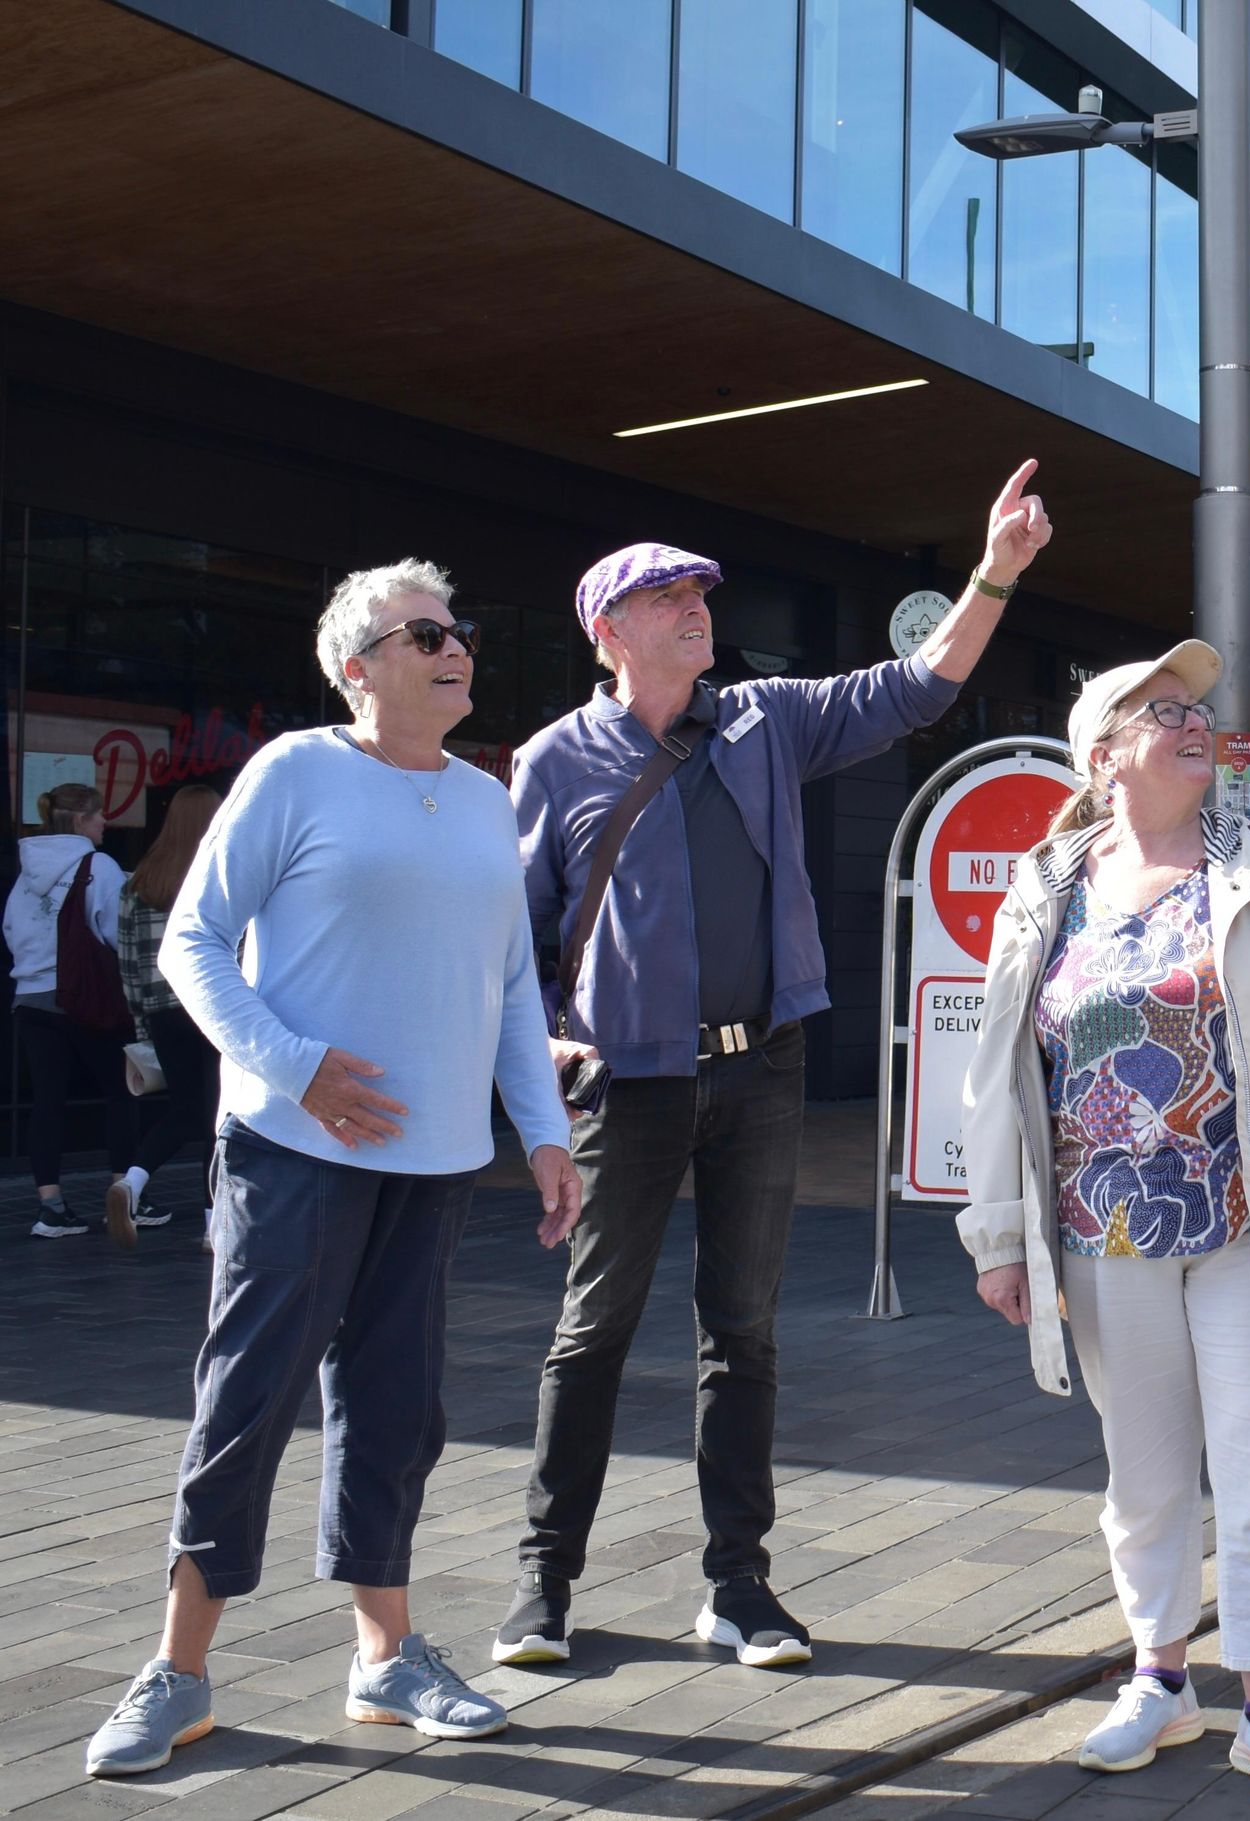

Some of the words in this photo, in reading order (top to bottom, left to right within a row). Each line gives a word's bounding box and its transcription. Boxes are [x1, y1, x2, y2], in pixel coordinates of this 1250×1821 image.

[895, 595, 927, 624] SWEET
[1070, 662, 1101, 683] SWE
[970, 859, 995, 885] NO
[933, 995, 985, 1010] EXCEP
[934, 1017, 981, 1032] DELIV
[946, 1162, 967, 1178] Tra
